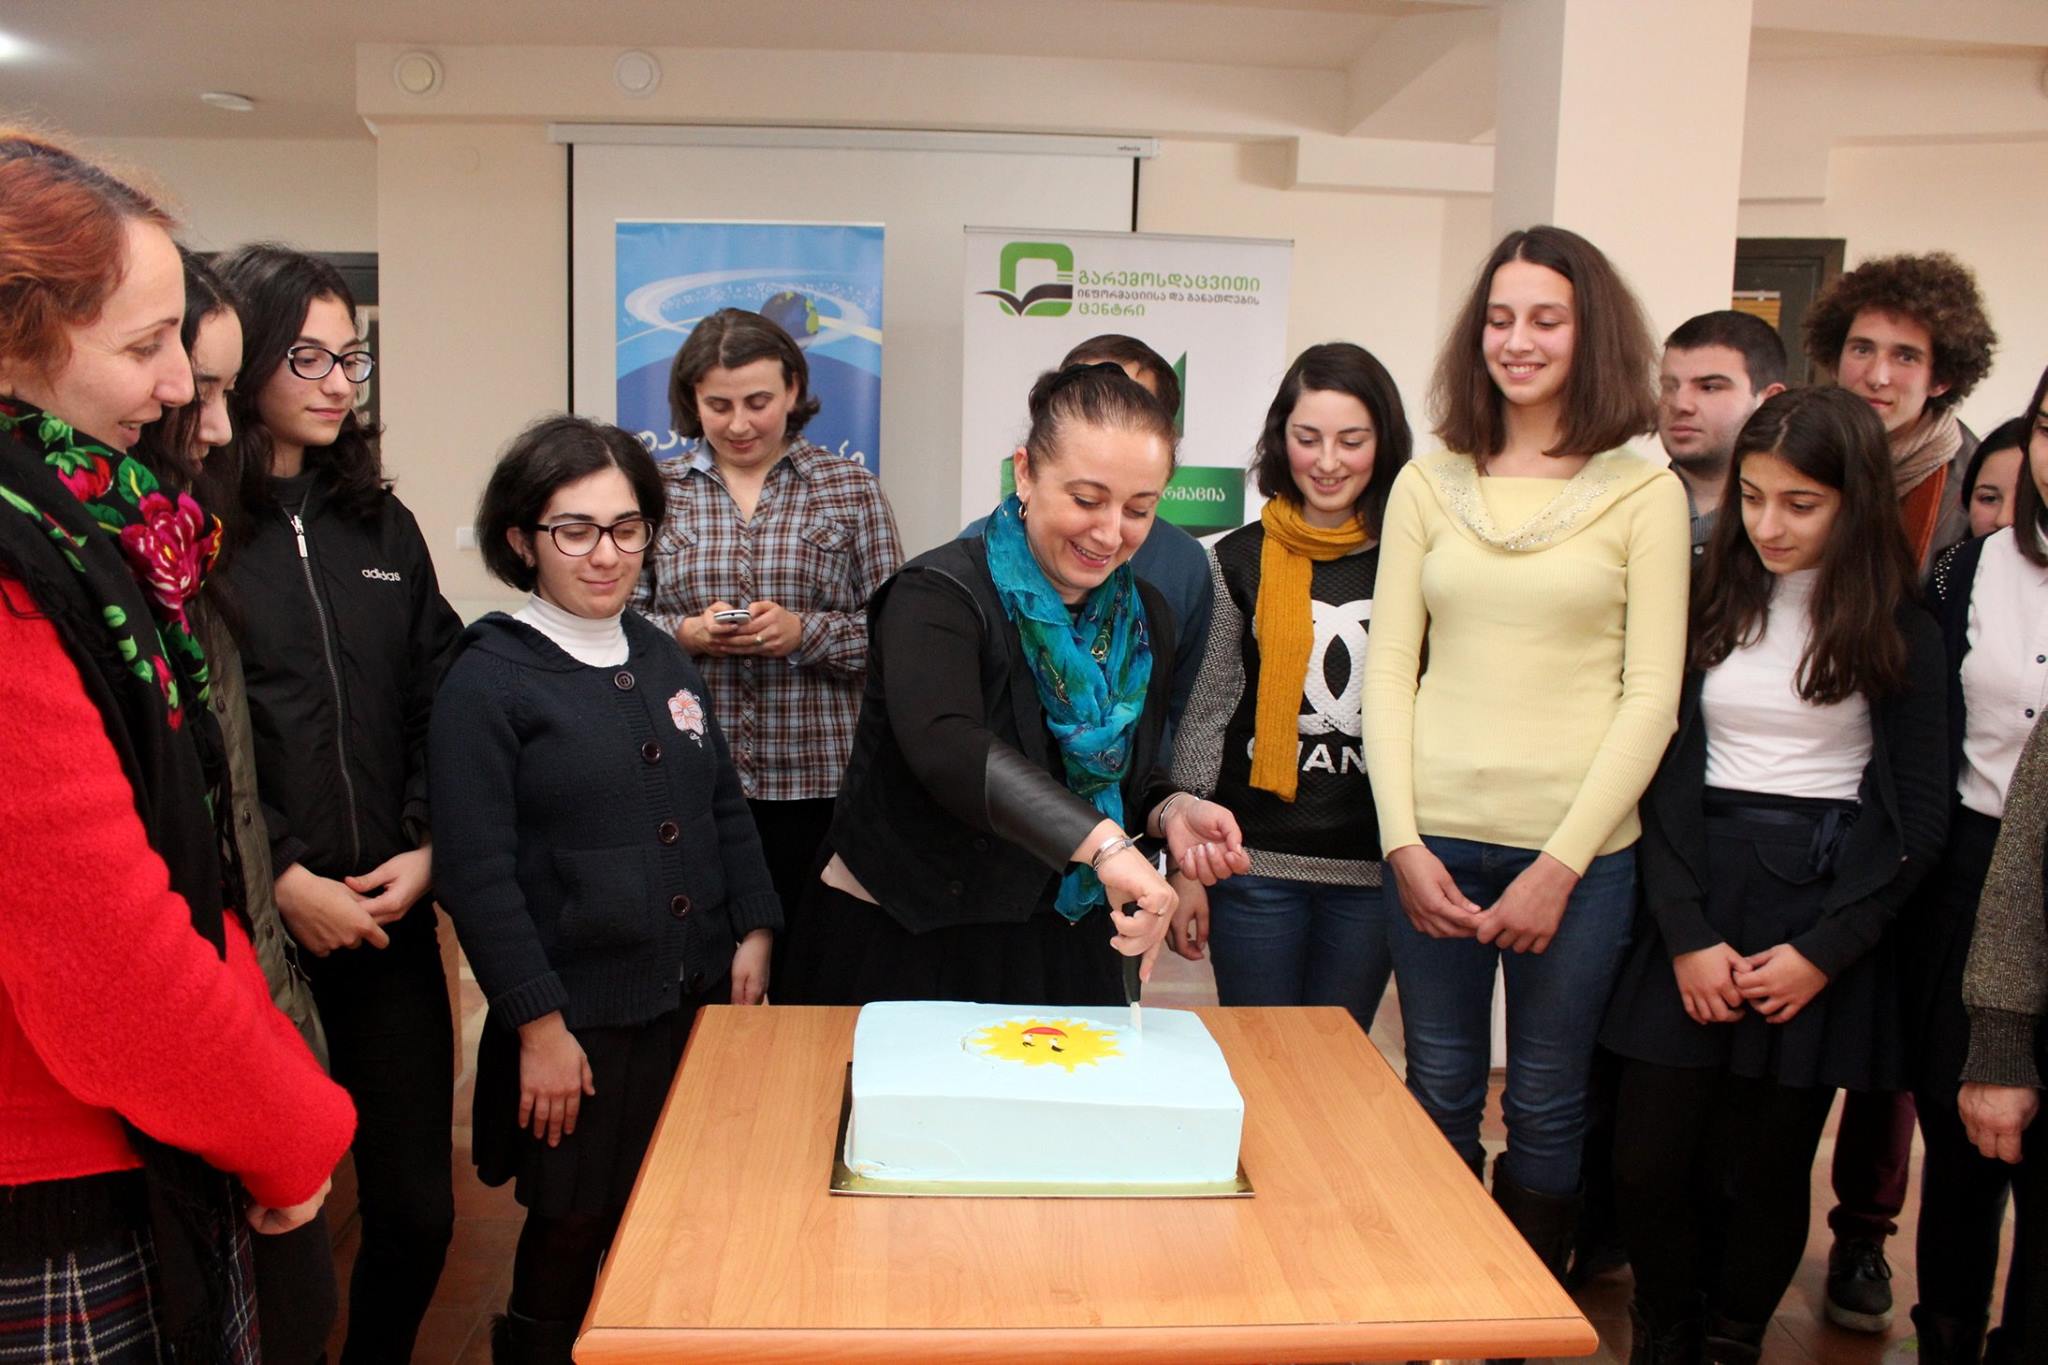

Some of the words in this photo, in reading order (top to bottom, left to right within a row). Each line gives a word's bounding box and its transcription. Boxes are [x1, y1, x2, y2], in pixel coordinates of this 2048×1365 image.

[1078, 270, 1260, 291] გარემოსდაცვითი
[1077, 289, 1167, 302] ინფორმაციისა
[1168, 291, 1185, 302] და
[1187, 292, 1260, 305] განათლების
[1078, 302, 1146, 317] ცენტრი
[1162, 485, 1226, 502] რმაცია
[361, 567, 401, 581] adidas
